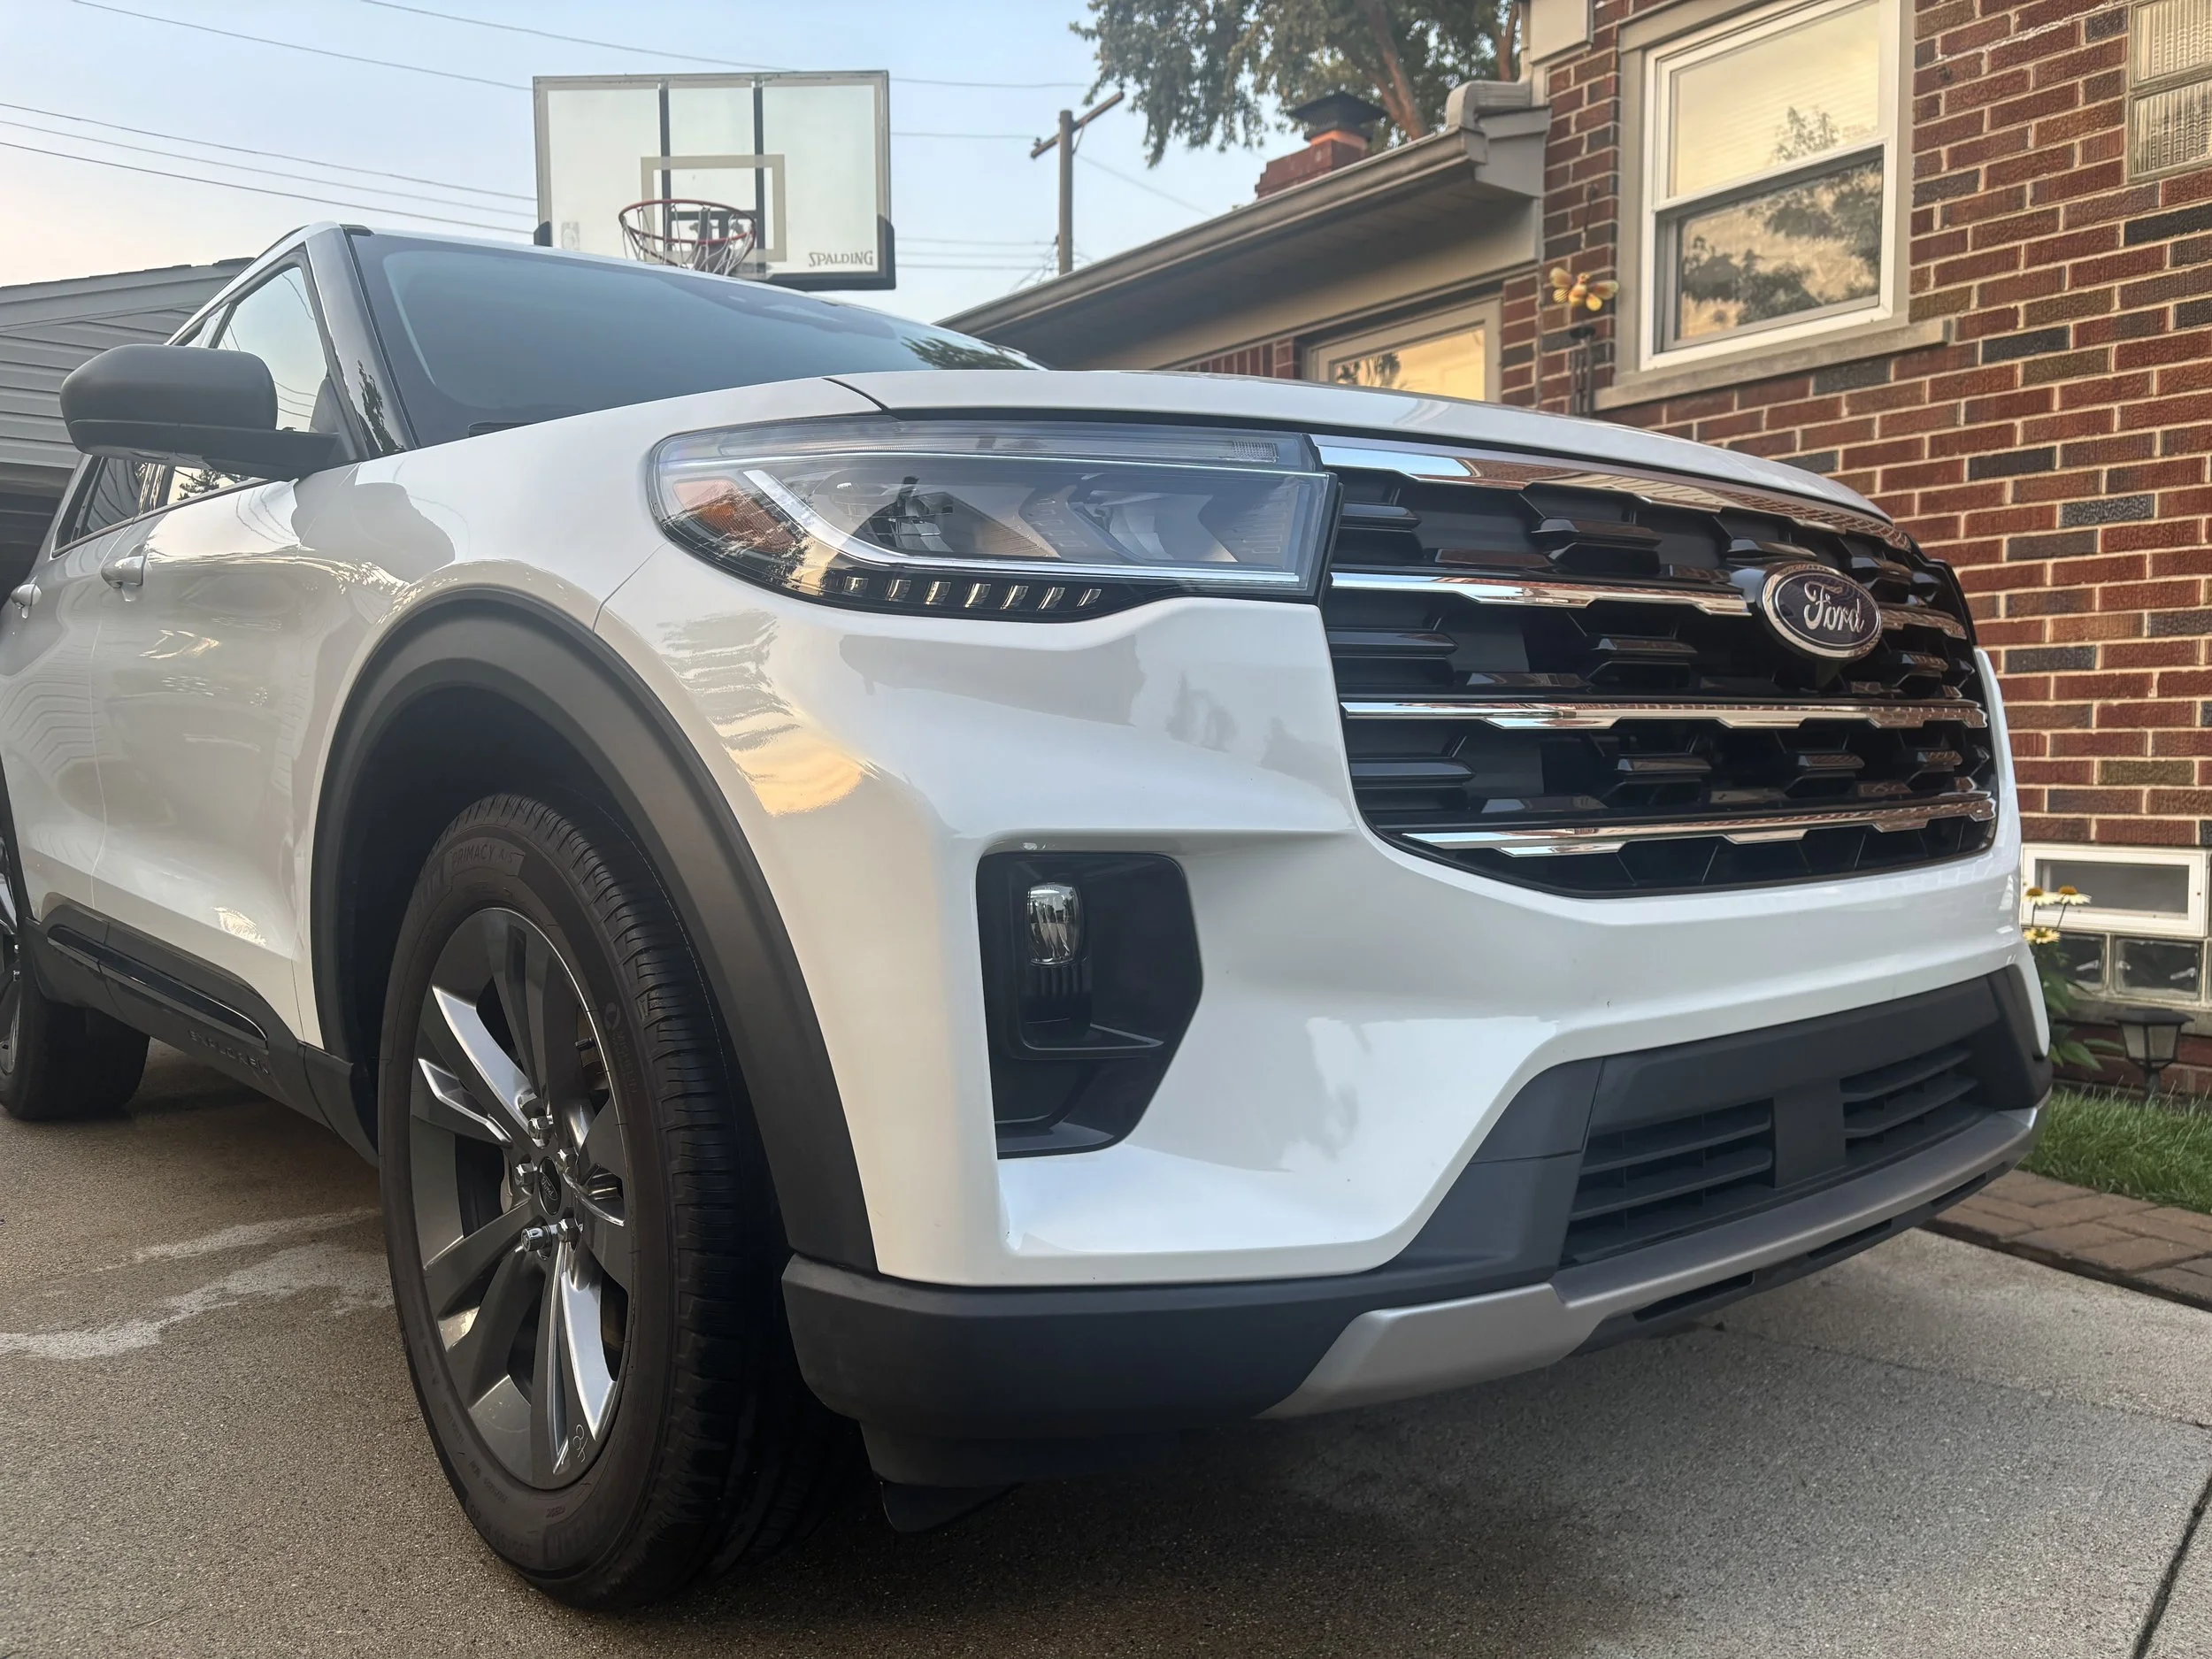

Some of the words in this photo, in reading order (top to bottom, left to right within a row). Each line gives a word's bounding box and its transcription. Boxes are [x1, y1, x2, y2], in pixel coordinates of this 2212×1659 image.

[809, 250, 873, 267] SPALDING
[1803, 580, 1865, 633] Ford
[450, 843, 496, 869] PRIMACY
